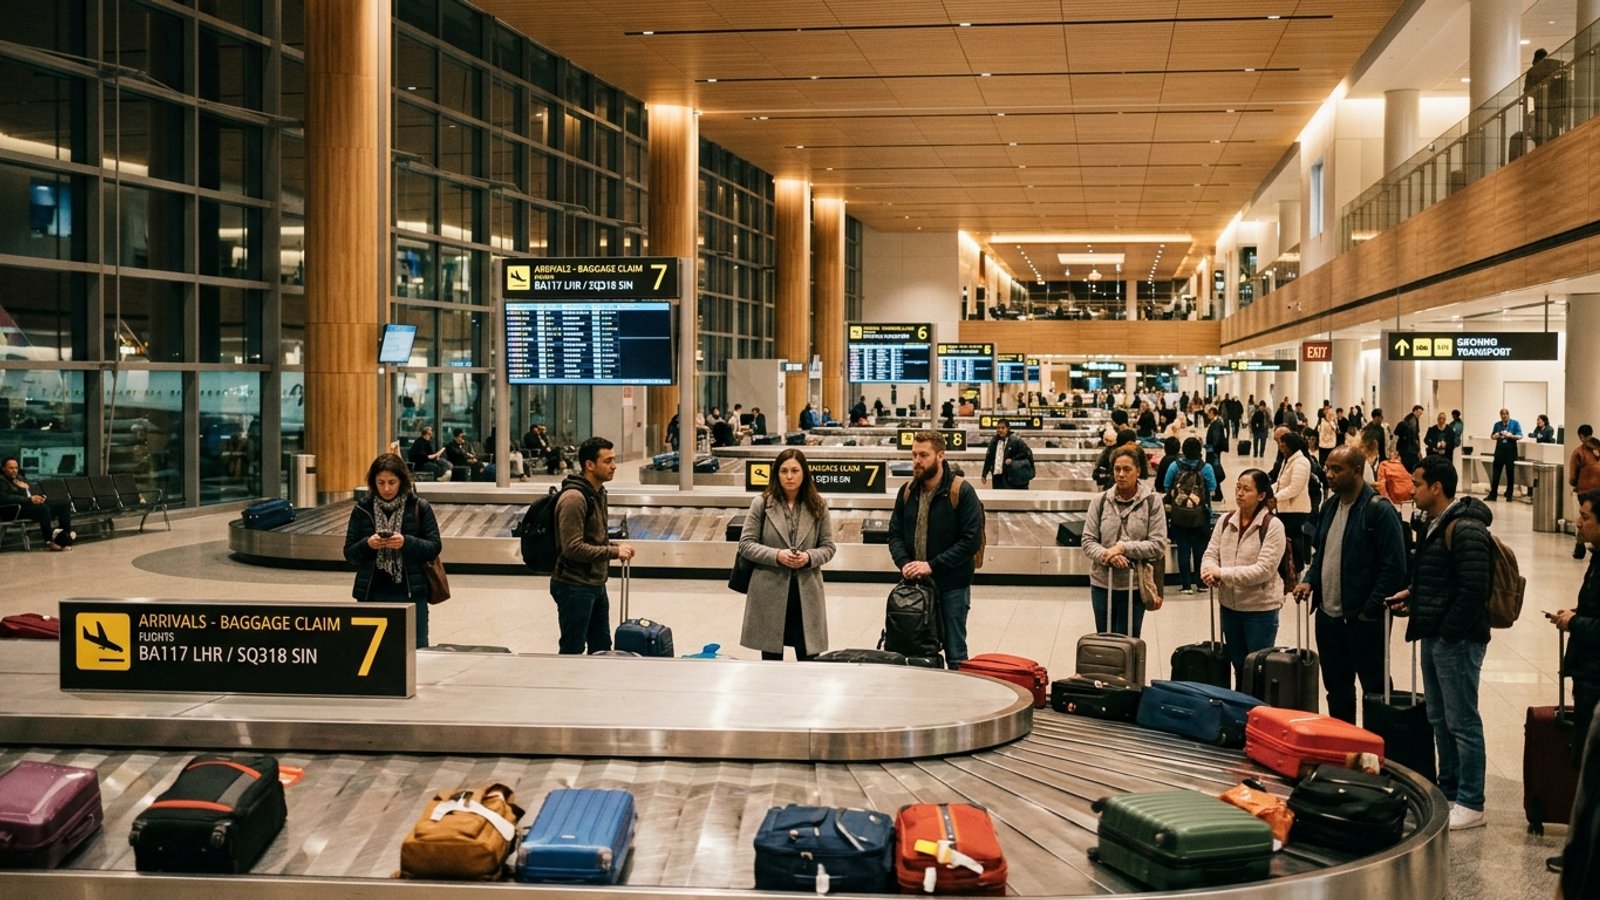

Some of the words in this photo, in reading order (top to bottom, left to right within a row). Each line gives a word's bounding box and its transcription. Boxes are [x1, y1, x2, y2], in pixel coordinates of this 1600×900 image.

[650, 264, 668, 290] 7
[918, 326, 928, 340] 6
[953, 432, 962, 446] 8
[864, 466, 879, 486] 7
[138, 614, 206, 629] ARRIVALS
[220, 616, 290, 630] BAGGAGE
[295, 617, 340, 631] CLAIM
[140, 646, 188, 661] BA117
[193, 646, 222, 662] LHR
[237, 647, 287, 664] SQ318
[291, 648, 318, 664] SIN
[350, 618, 388, 676] 7
